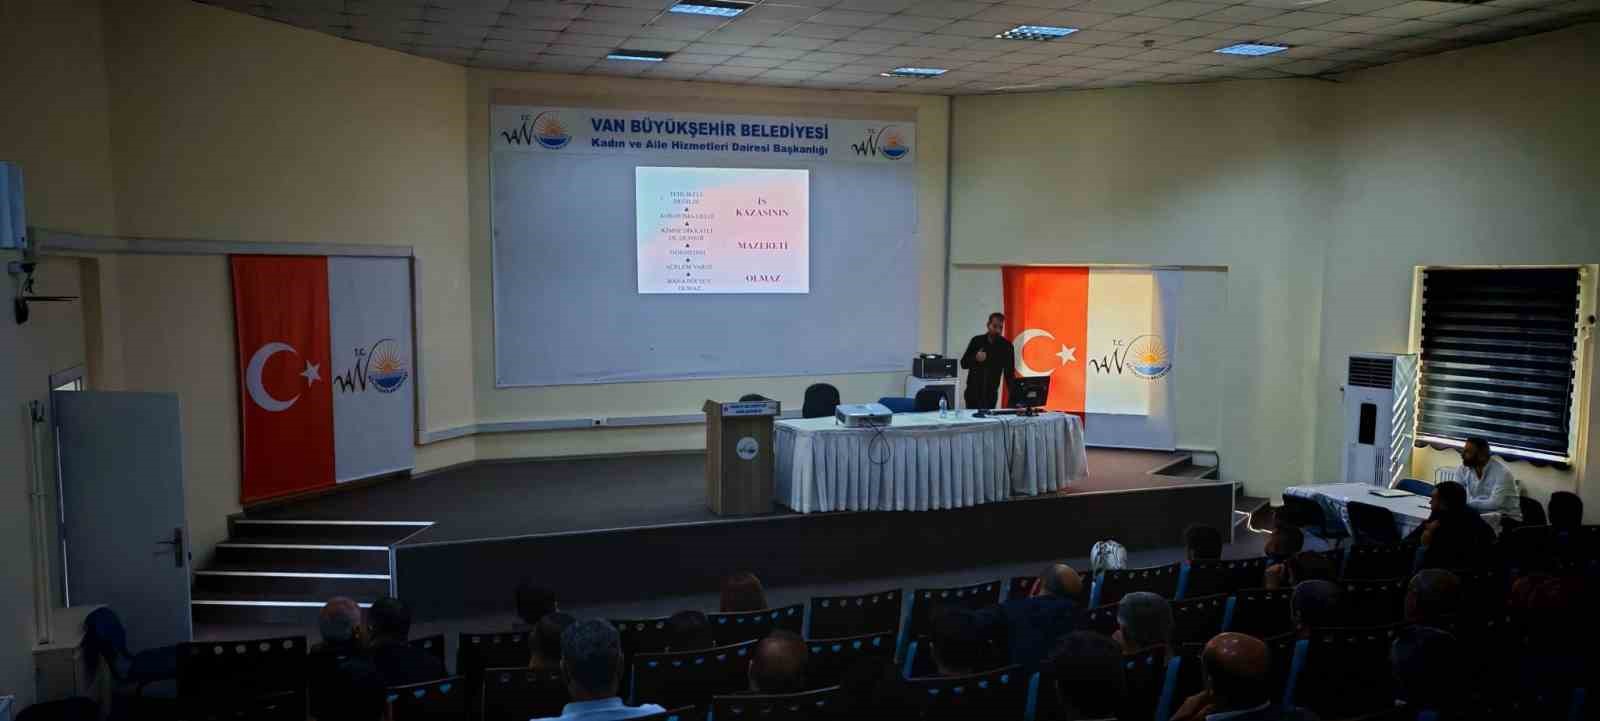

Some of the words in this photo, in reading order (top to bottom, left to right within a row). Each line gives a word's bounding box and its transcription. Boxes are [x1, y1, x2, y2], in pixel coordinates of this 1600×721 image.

[591, 117, 625, 133] VAN
[630, 116, 737, 138] BÜYÜKŞEHİR
[740, 121, 829, 140] BELEDİYESİ
[591, 137, 626, 149] Kadın
[629, 140, 643, 149] ve
[646, 138, 668, 150] Aile
[671, 138, 729, 151] Hizmetleri
[731, 142, 771, 153] Dairesi
[773, 143, 829, 156] Başkanlığı
[736, 208, 790, 217] KAZASININ
[745, 273, 782, 283] OLMAZ
